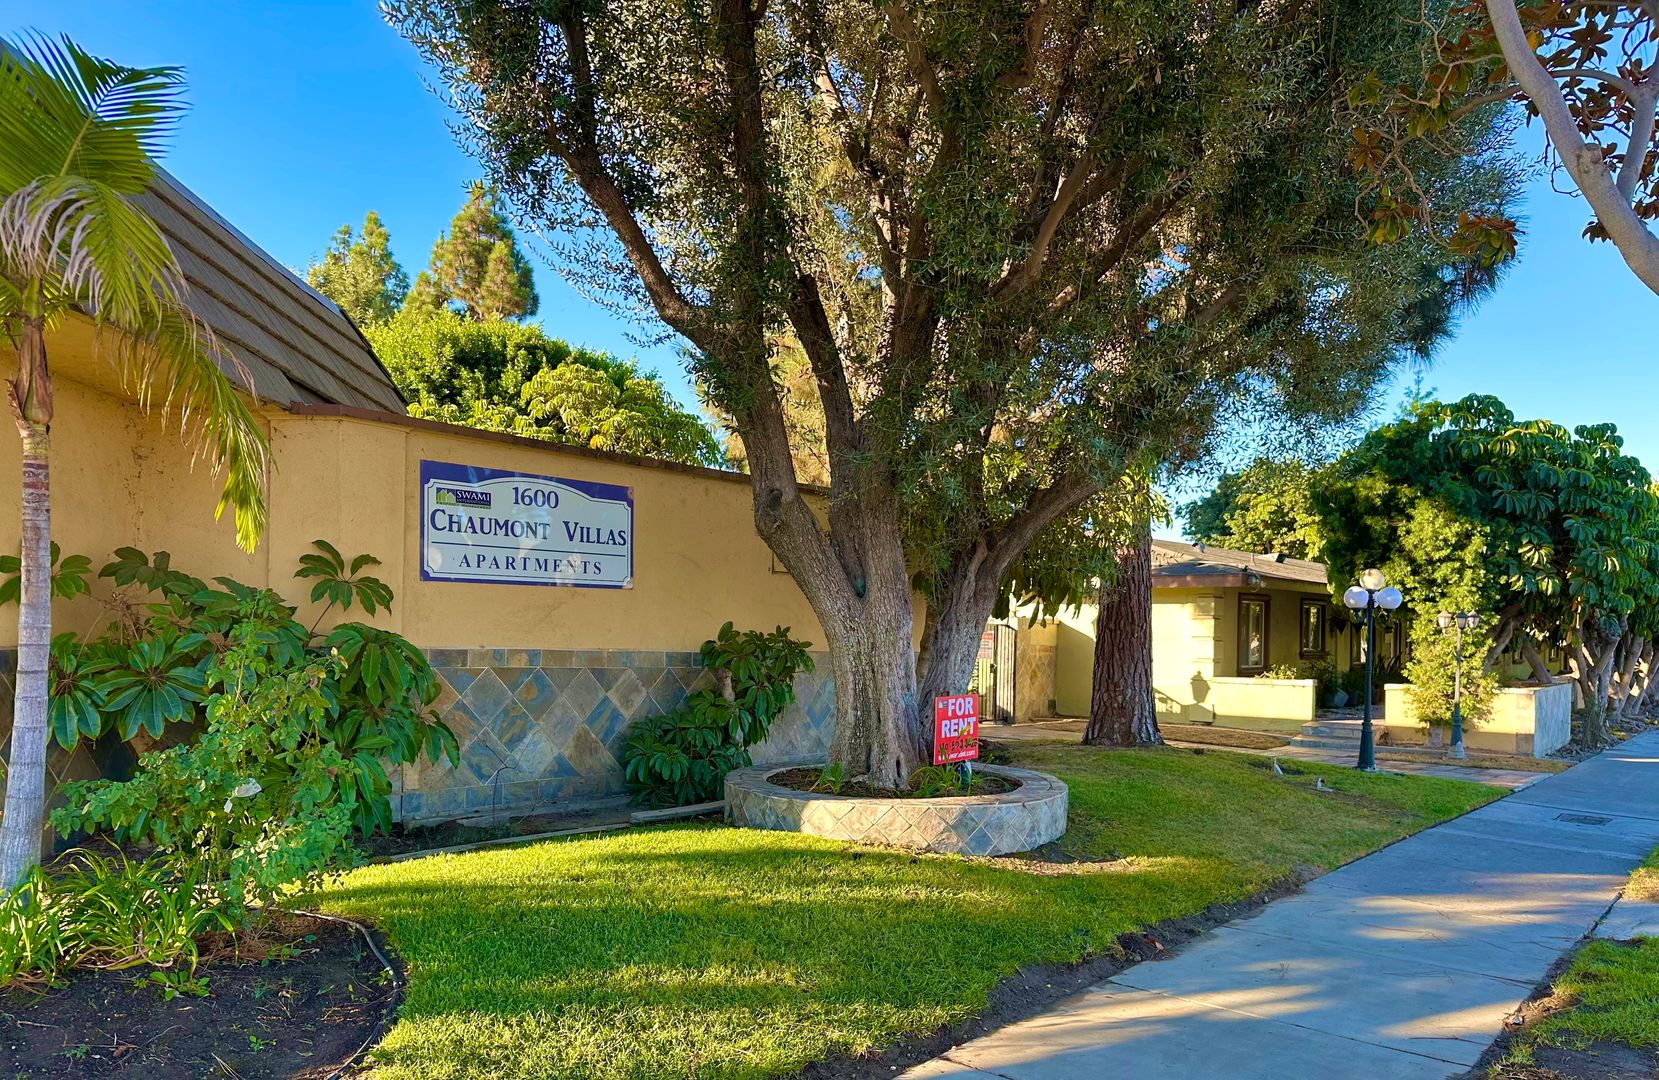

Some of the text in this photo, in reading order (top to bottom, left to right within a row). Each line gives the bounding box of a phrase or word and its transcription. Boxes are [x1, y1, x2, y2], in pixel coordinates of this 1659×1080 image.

[456, 490, 490, 502] SWAMI
[512, 486, 559, 509] 1600
[430, 508, 627, 546] CHAUMONT VILLAS
[459, 553, 602, 575] APARTMENTS
[948, 698, 973, 716] FOR
[941, 717, 976, 738] RENT
